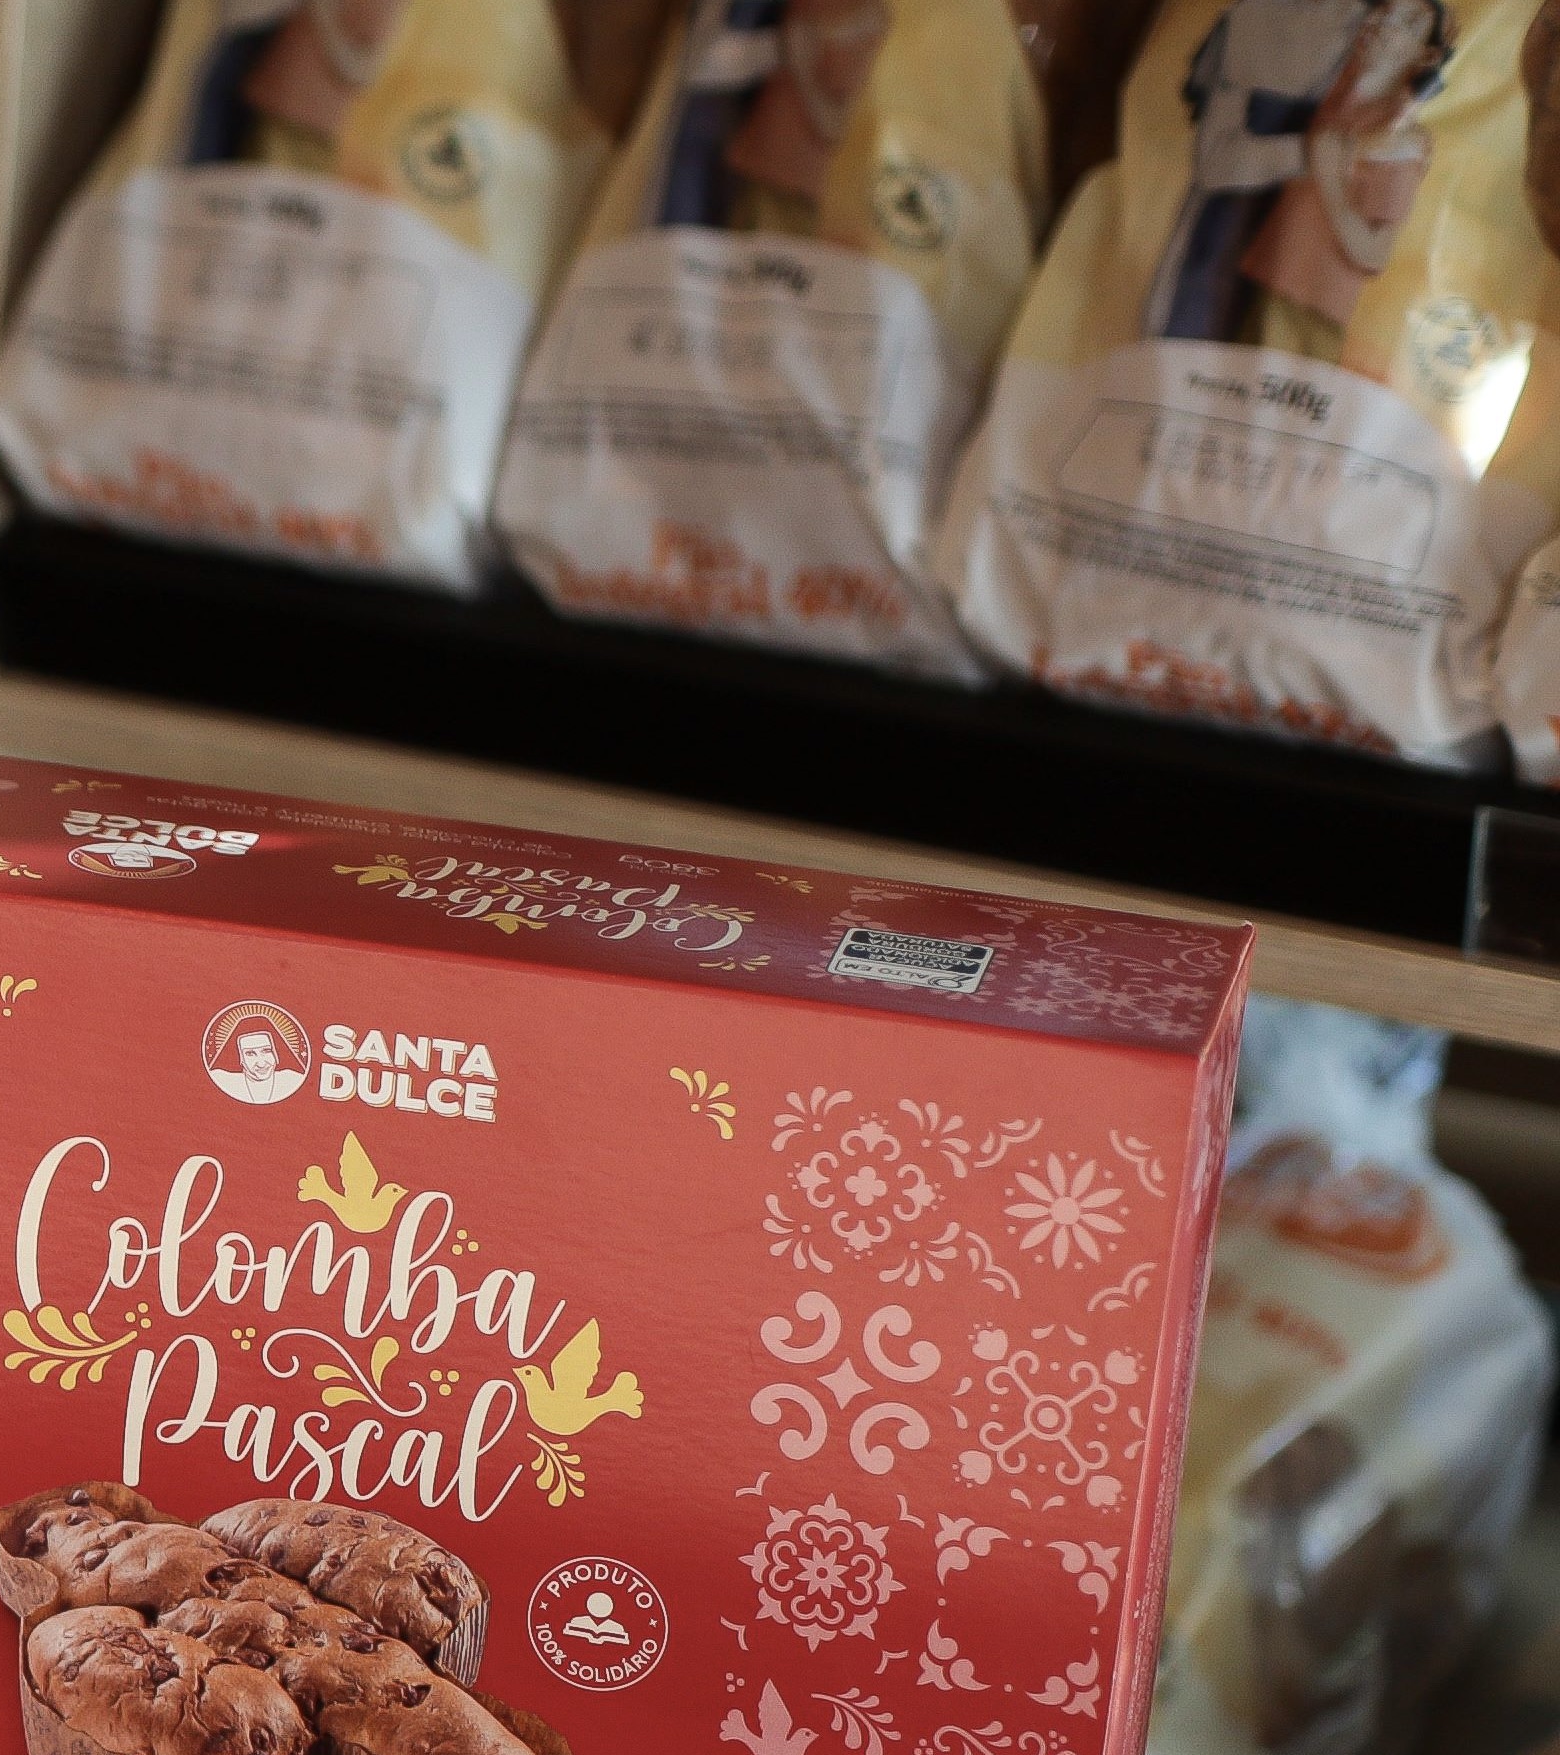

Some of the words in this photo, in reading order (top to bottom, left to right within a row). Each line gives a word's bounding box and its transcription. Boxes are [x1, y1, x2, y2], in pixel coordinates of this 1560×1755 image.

[63, 822, 247, 855] SANTA
[64, 810, 260, 847] DULCE
[417, 852, 681, 910] Pascal
[383, 877, 743, 953] Colomba
[843, 962, 872, 972] EM
[849, 944, 977, 967] ADICIONADO
[879, 967, 928, 980] ALTO
[322, 1024, 496, 1073] SANTA
[318, 1066, 499, 1122] DULCE
[14, 1134, 566, 1360] Colomba
[121, 1333, 526, 1524] Pascal
[546, 1564, 654, 1609] PRODUTO
[536, 1623, 567, 1665] 100%
[567, 1638, 658, 1683] SOLIDÁRIO
